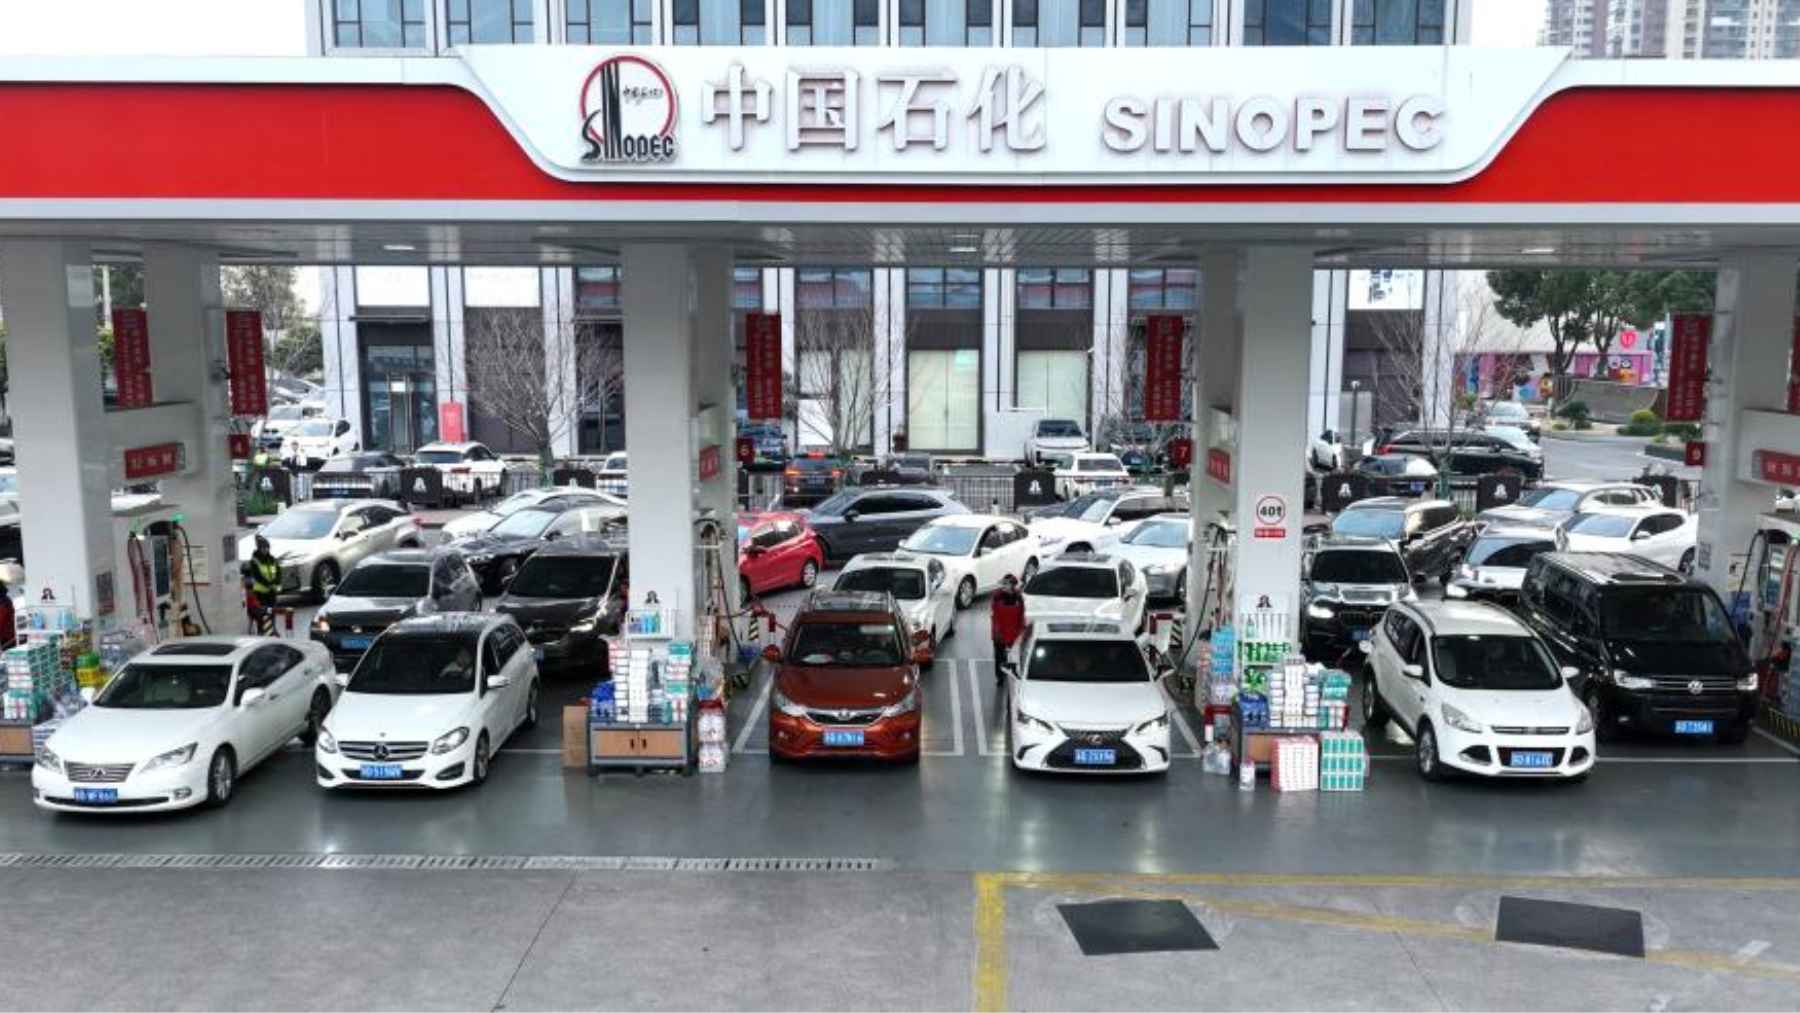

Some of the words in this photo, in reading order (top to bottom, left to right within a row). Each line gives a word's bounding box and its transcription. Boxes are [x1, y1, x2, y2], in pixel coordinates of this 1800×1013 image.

[701, 63, 1046, 152] 中国石化
[1102, 95, 1445, 153] SINOPEC
